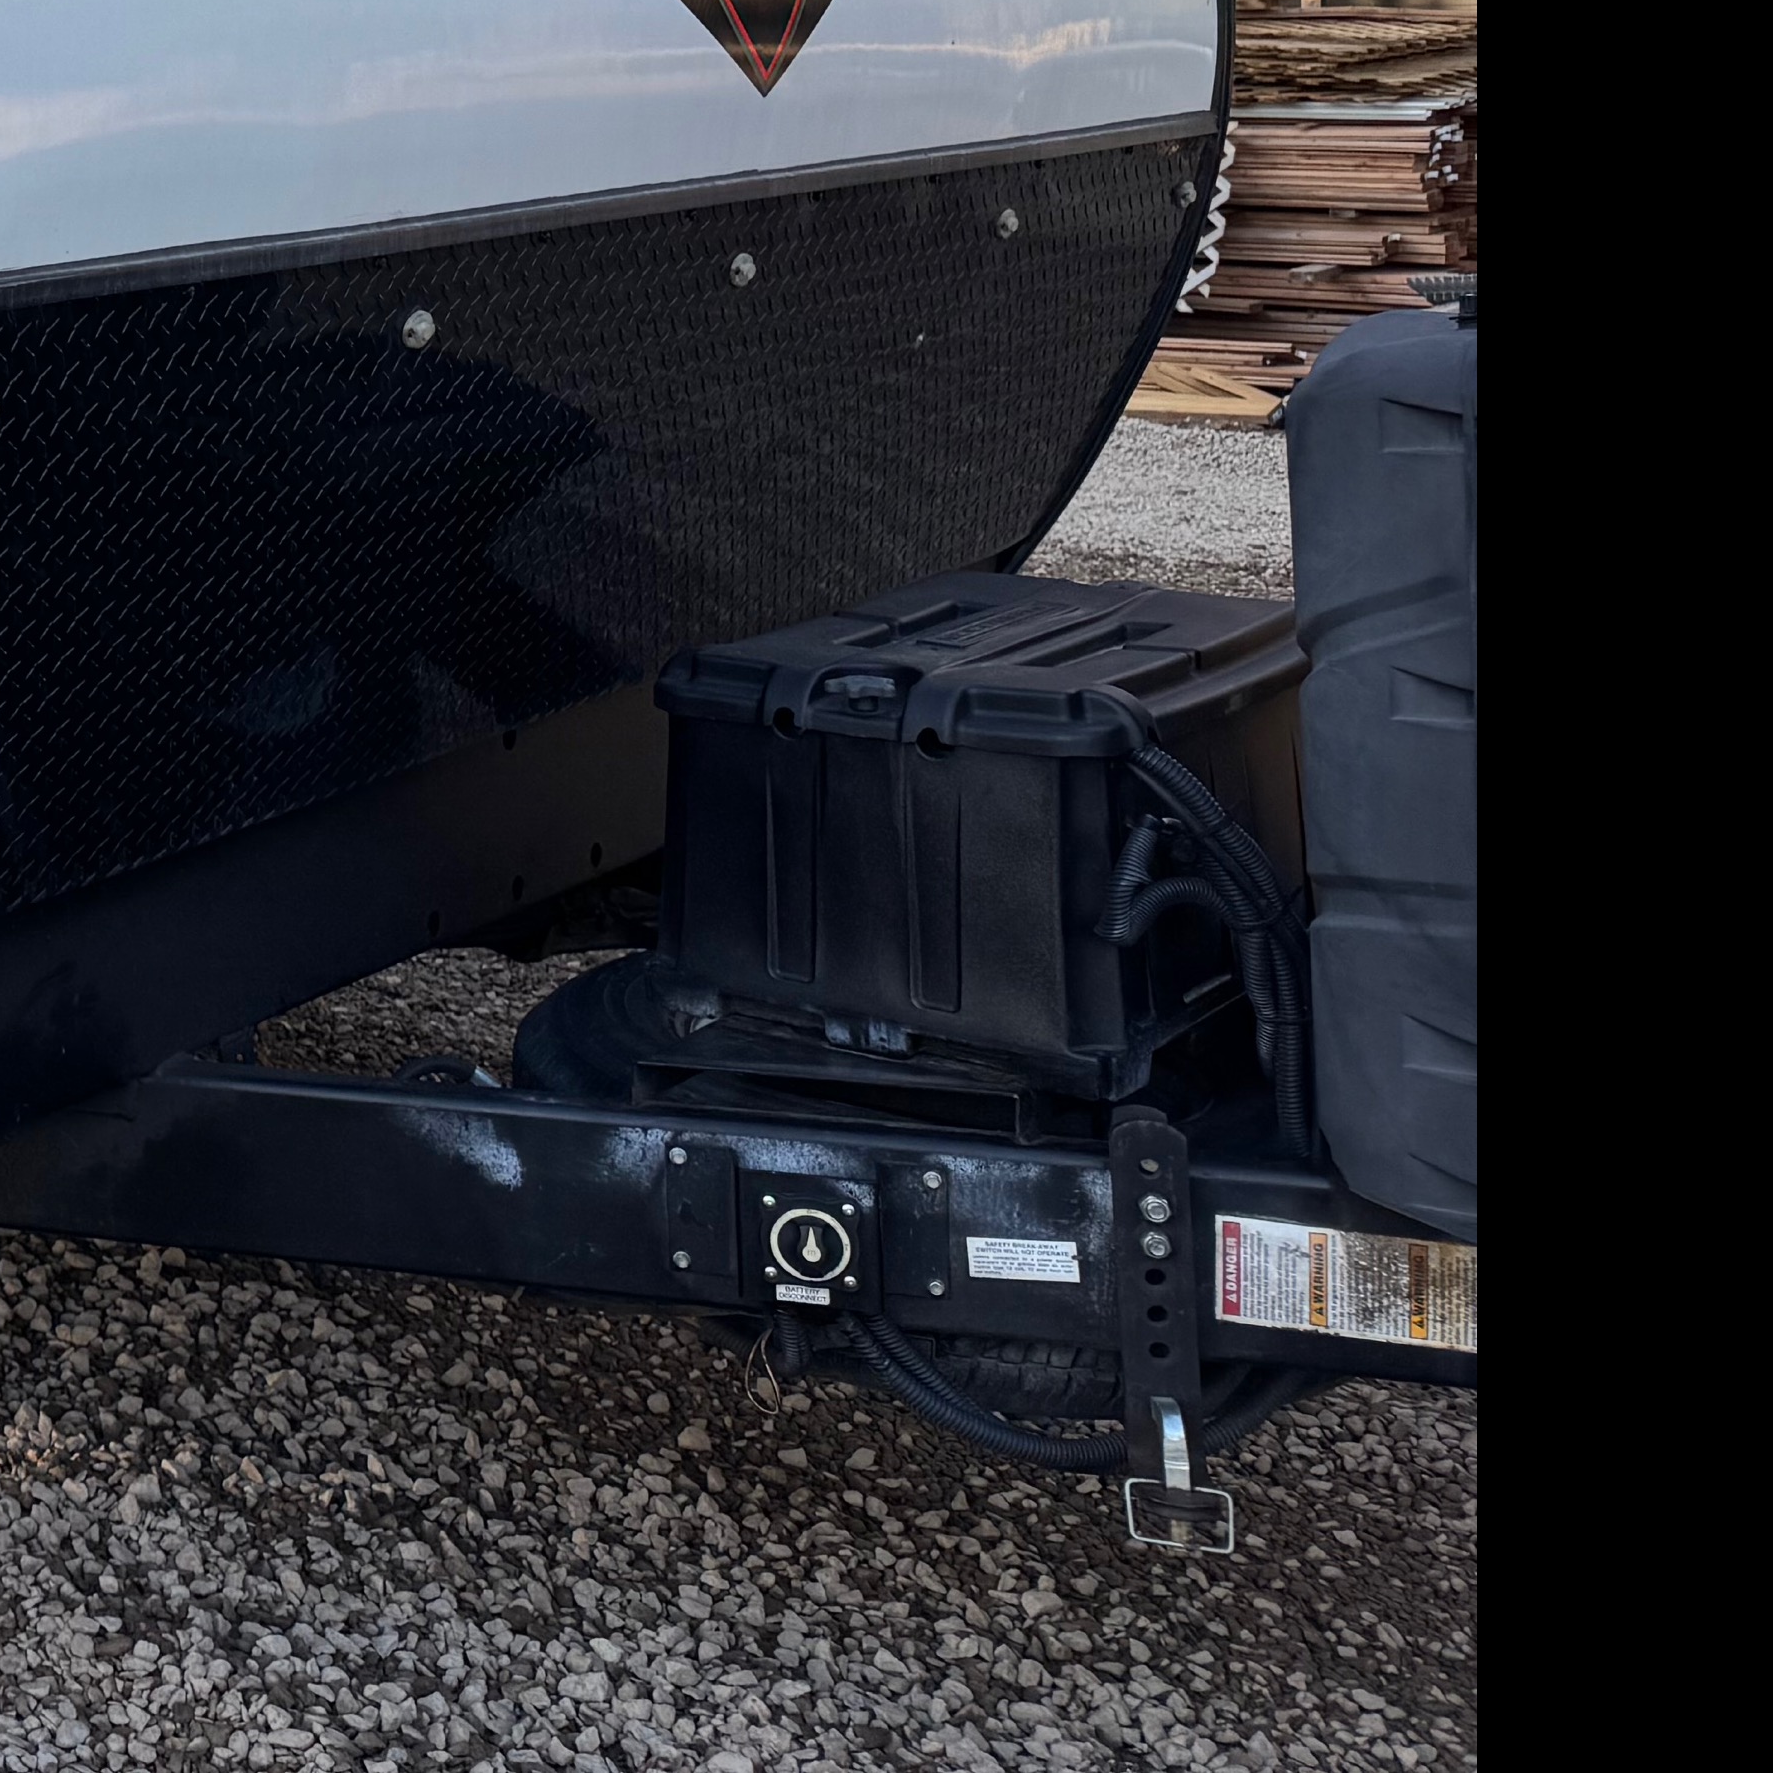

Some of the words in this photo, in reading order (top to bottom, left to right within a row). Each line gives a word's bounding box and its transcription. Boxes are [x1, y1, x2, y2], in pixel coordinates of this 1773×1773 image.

[784, 1285, 821, 1296] BATTERY
[1225, 1237, 1238, 1291] DANGER
[1312, 1242, 1324, 1304] WARNING
[1412, 1255, 1425, 1317] WARNING
